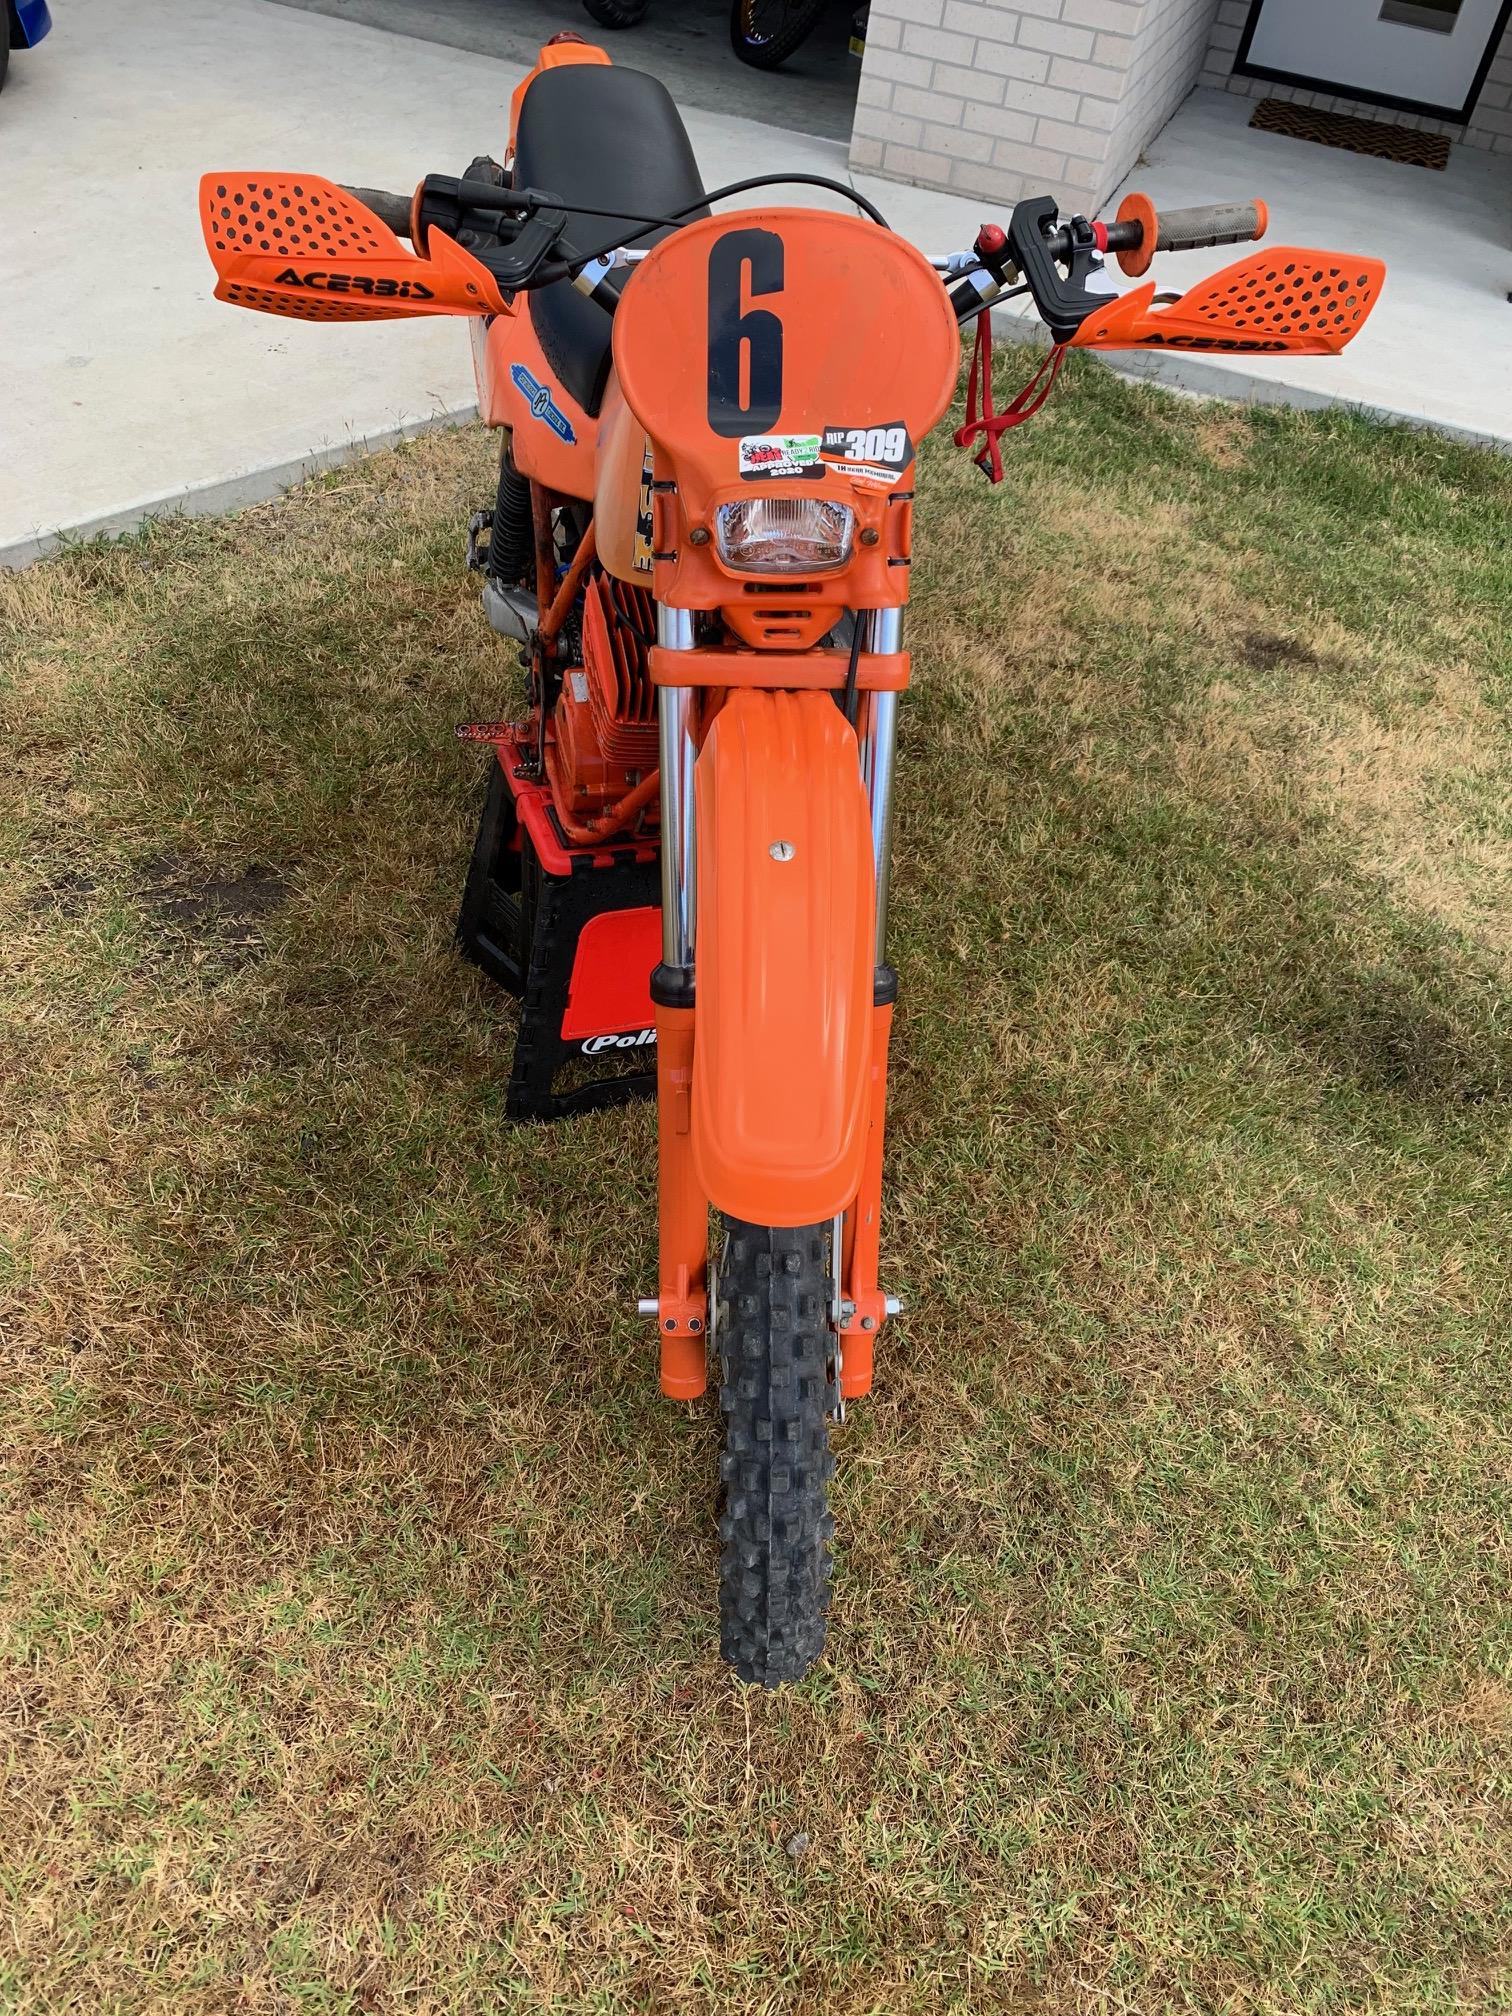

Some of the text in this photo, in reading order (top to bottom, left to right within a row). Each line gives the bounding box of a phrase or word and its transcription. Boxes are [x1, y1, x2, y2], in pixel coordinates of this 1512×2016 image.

[707, 227, 785, 439] 6
[825, 431, 845, 446] RIP
[844, 427, 907, 462] 309
[752, 459, 814, 472] APPROVED
[770, 466, 804, 477] 2020
[586, 1028, 657, 1054] Poli
